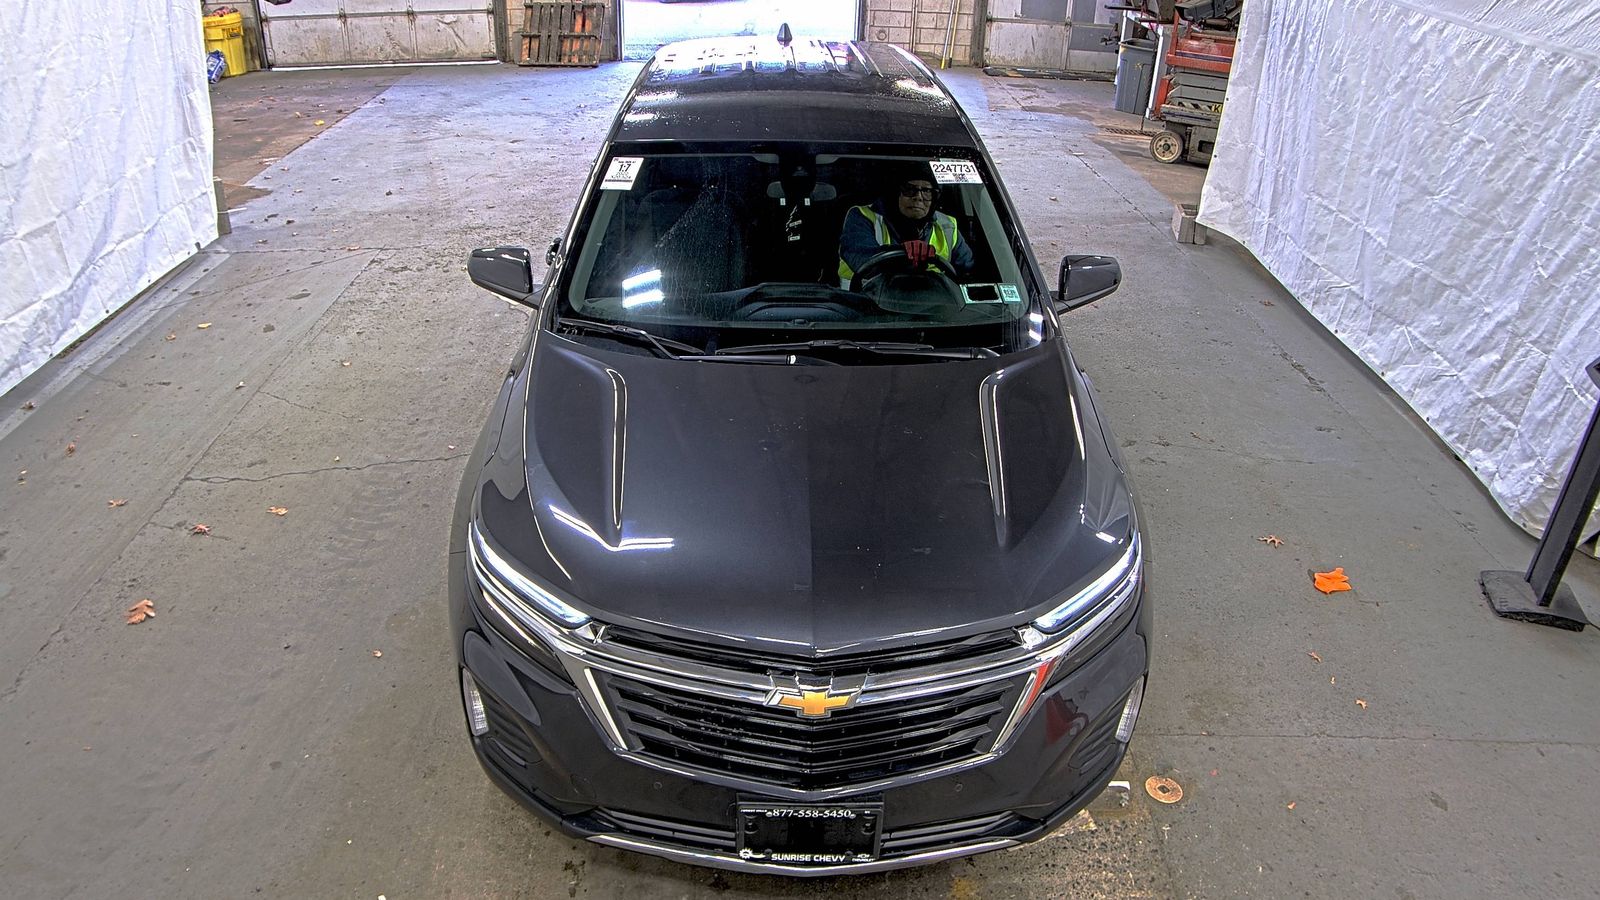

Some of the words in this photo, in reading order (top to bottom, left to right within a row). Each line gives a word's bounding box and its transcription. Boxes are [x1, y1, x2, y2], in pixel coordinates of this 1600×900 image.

[932, 163, 976, 173] 2247731
[772, 809, 851, 818] 877-558-5450
[771, 853, 811, 861] SUNRISE
[813, 854, 845, 862] CHEVY
